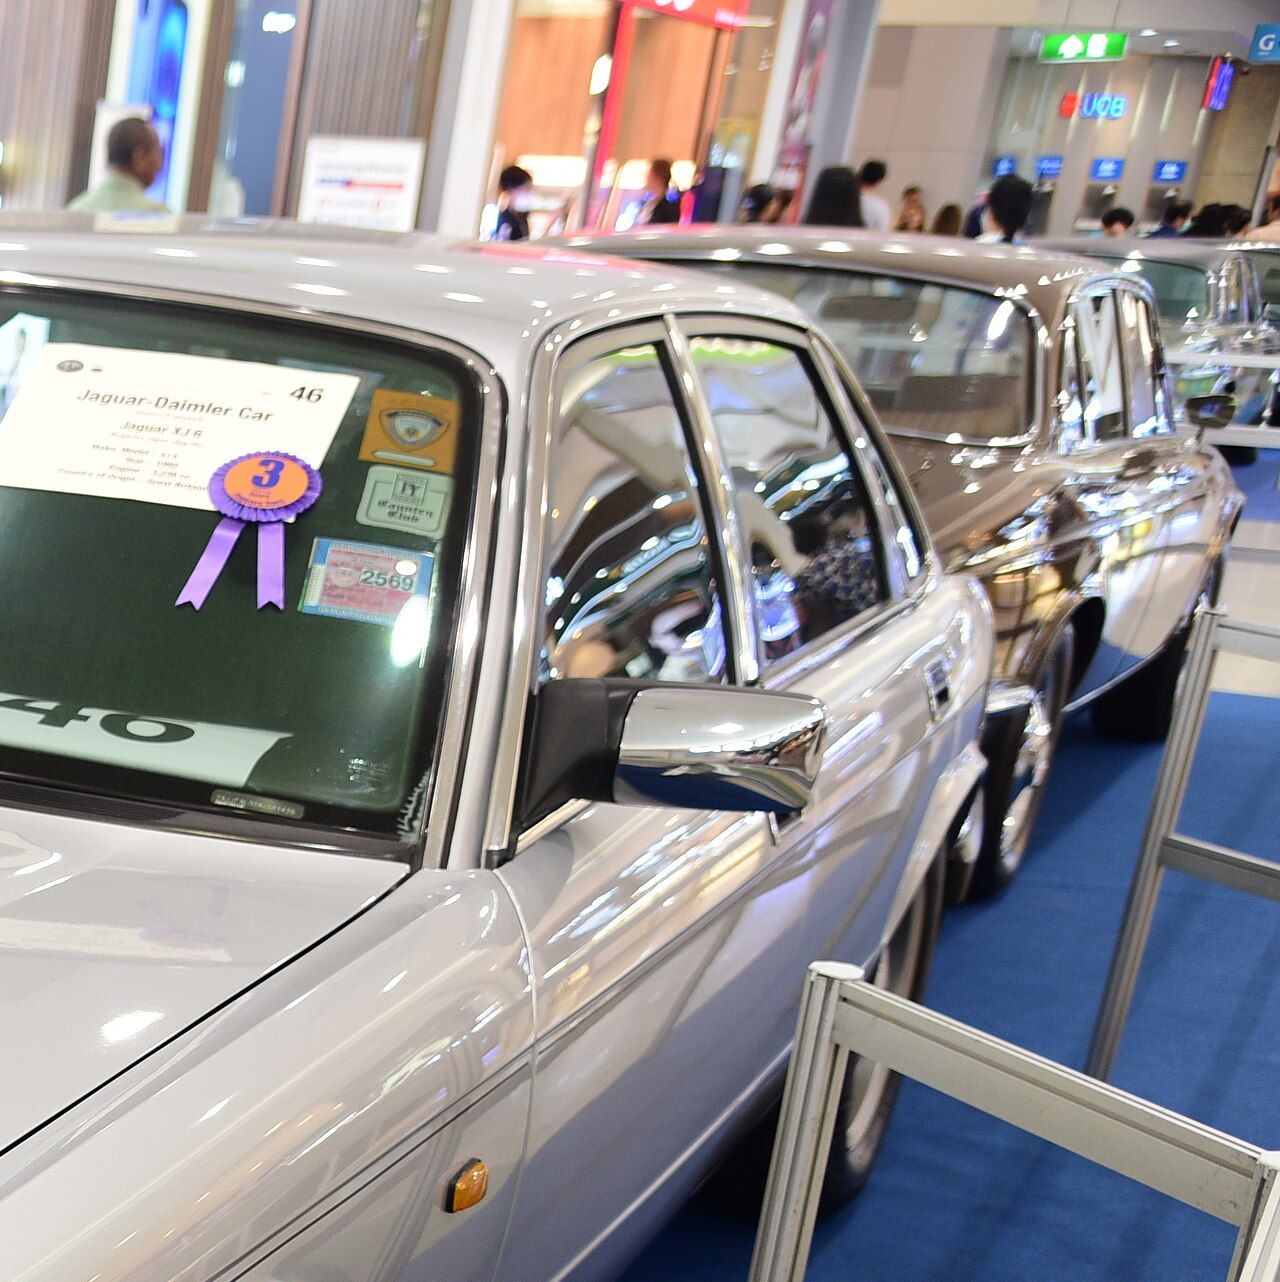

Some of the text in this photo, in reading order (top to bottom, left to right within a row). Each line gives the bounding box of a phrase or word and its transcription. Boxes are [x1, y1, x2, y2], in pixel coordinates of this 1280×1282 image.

[76, 388, 233, 417] Jaguar-Daimler
[238, 407, 274, 423] Car
[289, 386, 324, 404] 46
[119, 421, 169, 434] Jaguar
[252, 458, 285, 488] 3
[360, 570, 415, 592] 2569
